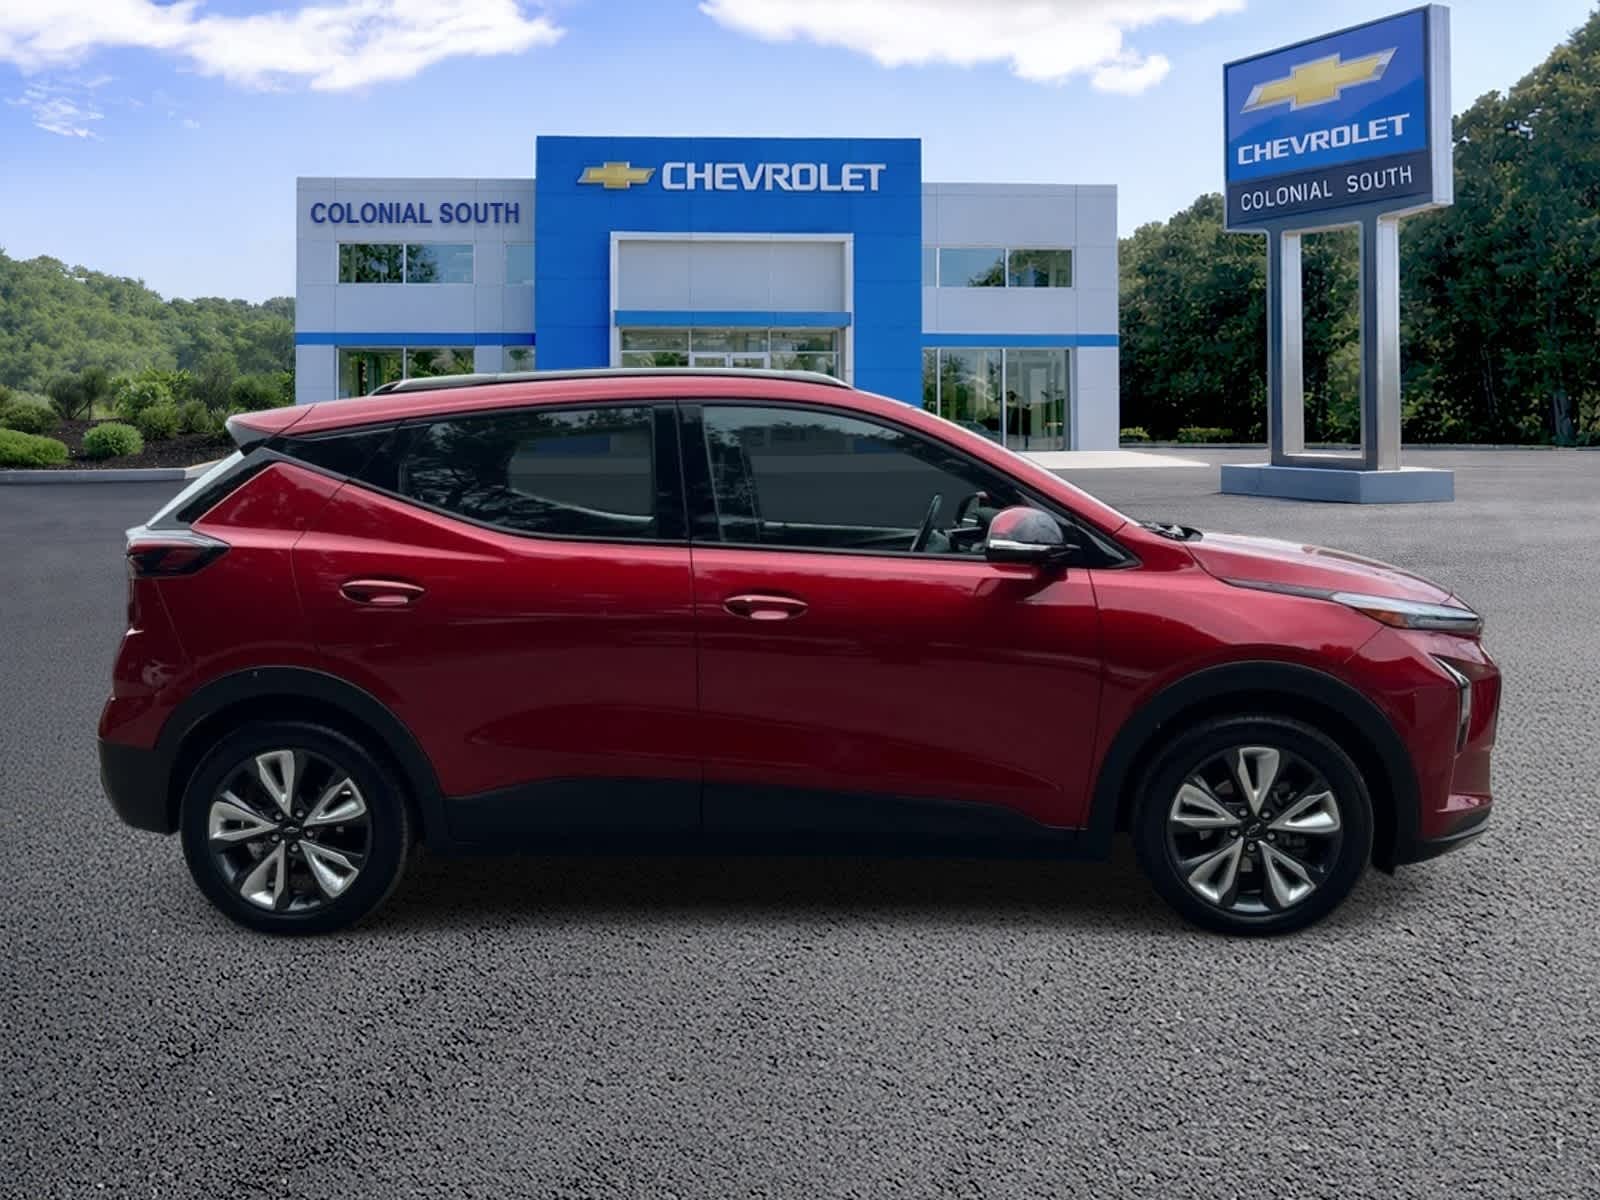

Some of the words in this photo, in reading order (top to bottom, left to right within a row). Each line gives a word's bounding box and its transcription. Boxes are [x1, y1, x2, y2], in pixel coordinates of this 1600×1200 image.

[1238, 113, 1410, 165] CHEVROLET
[661, 162, 887, 192] CHEVROLET
[1241, 180, 1333, 211] COLONIAL
[1347, 165, 1412, 193] SOUTH
[310, 202, 433, 224] COLONIAL
[439, 202, 520, 224] SOUTH
